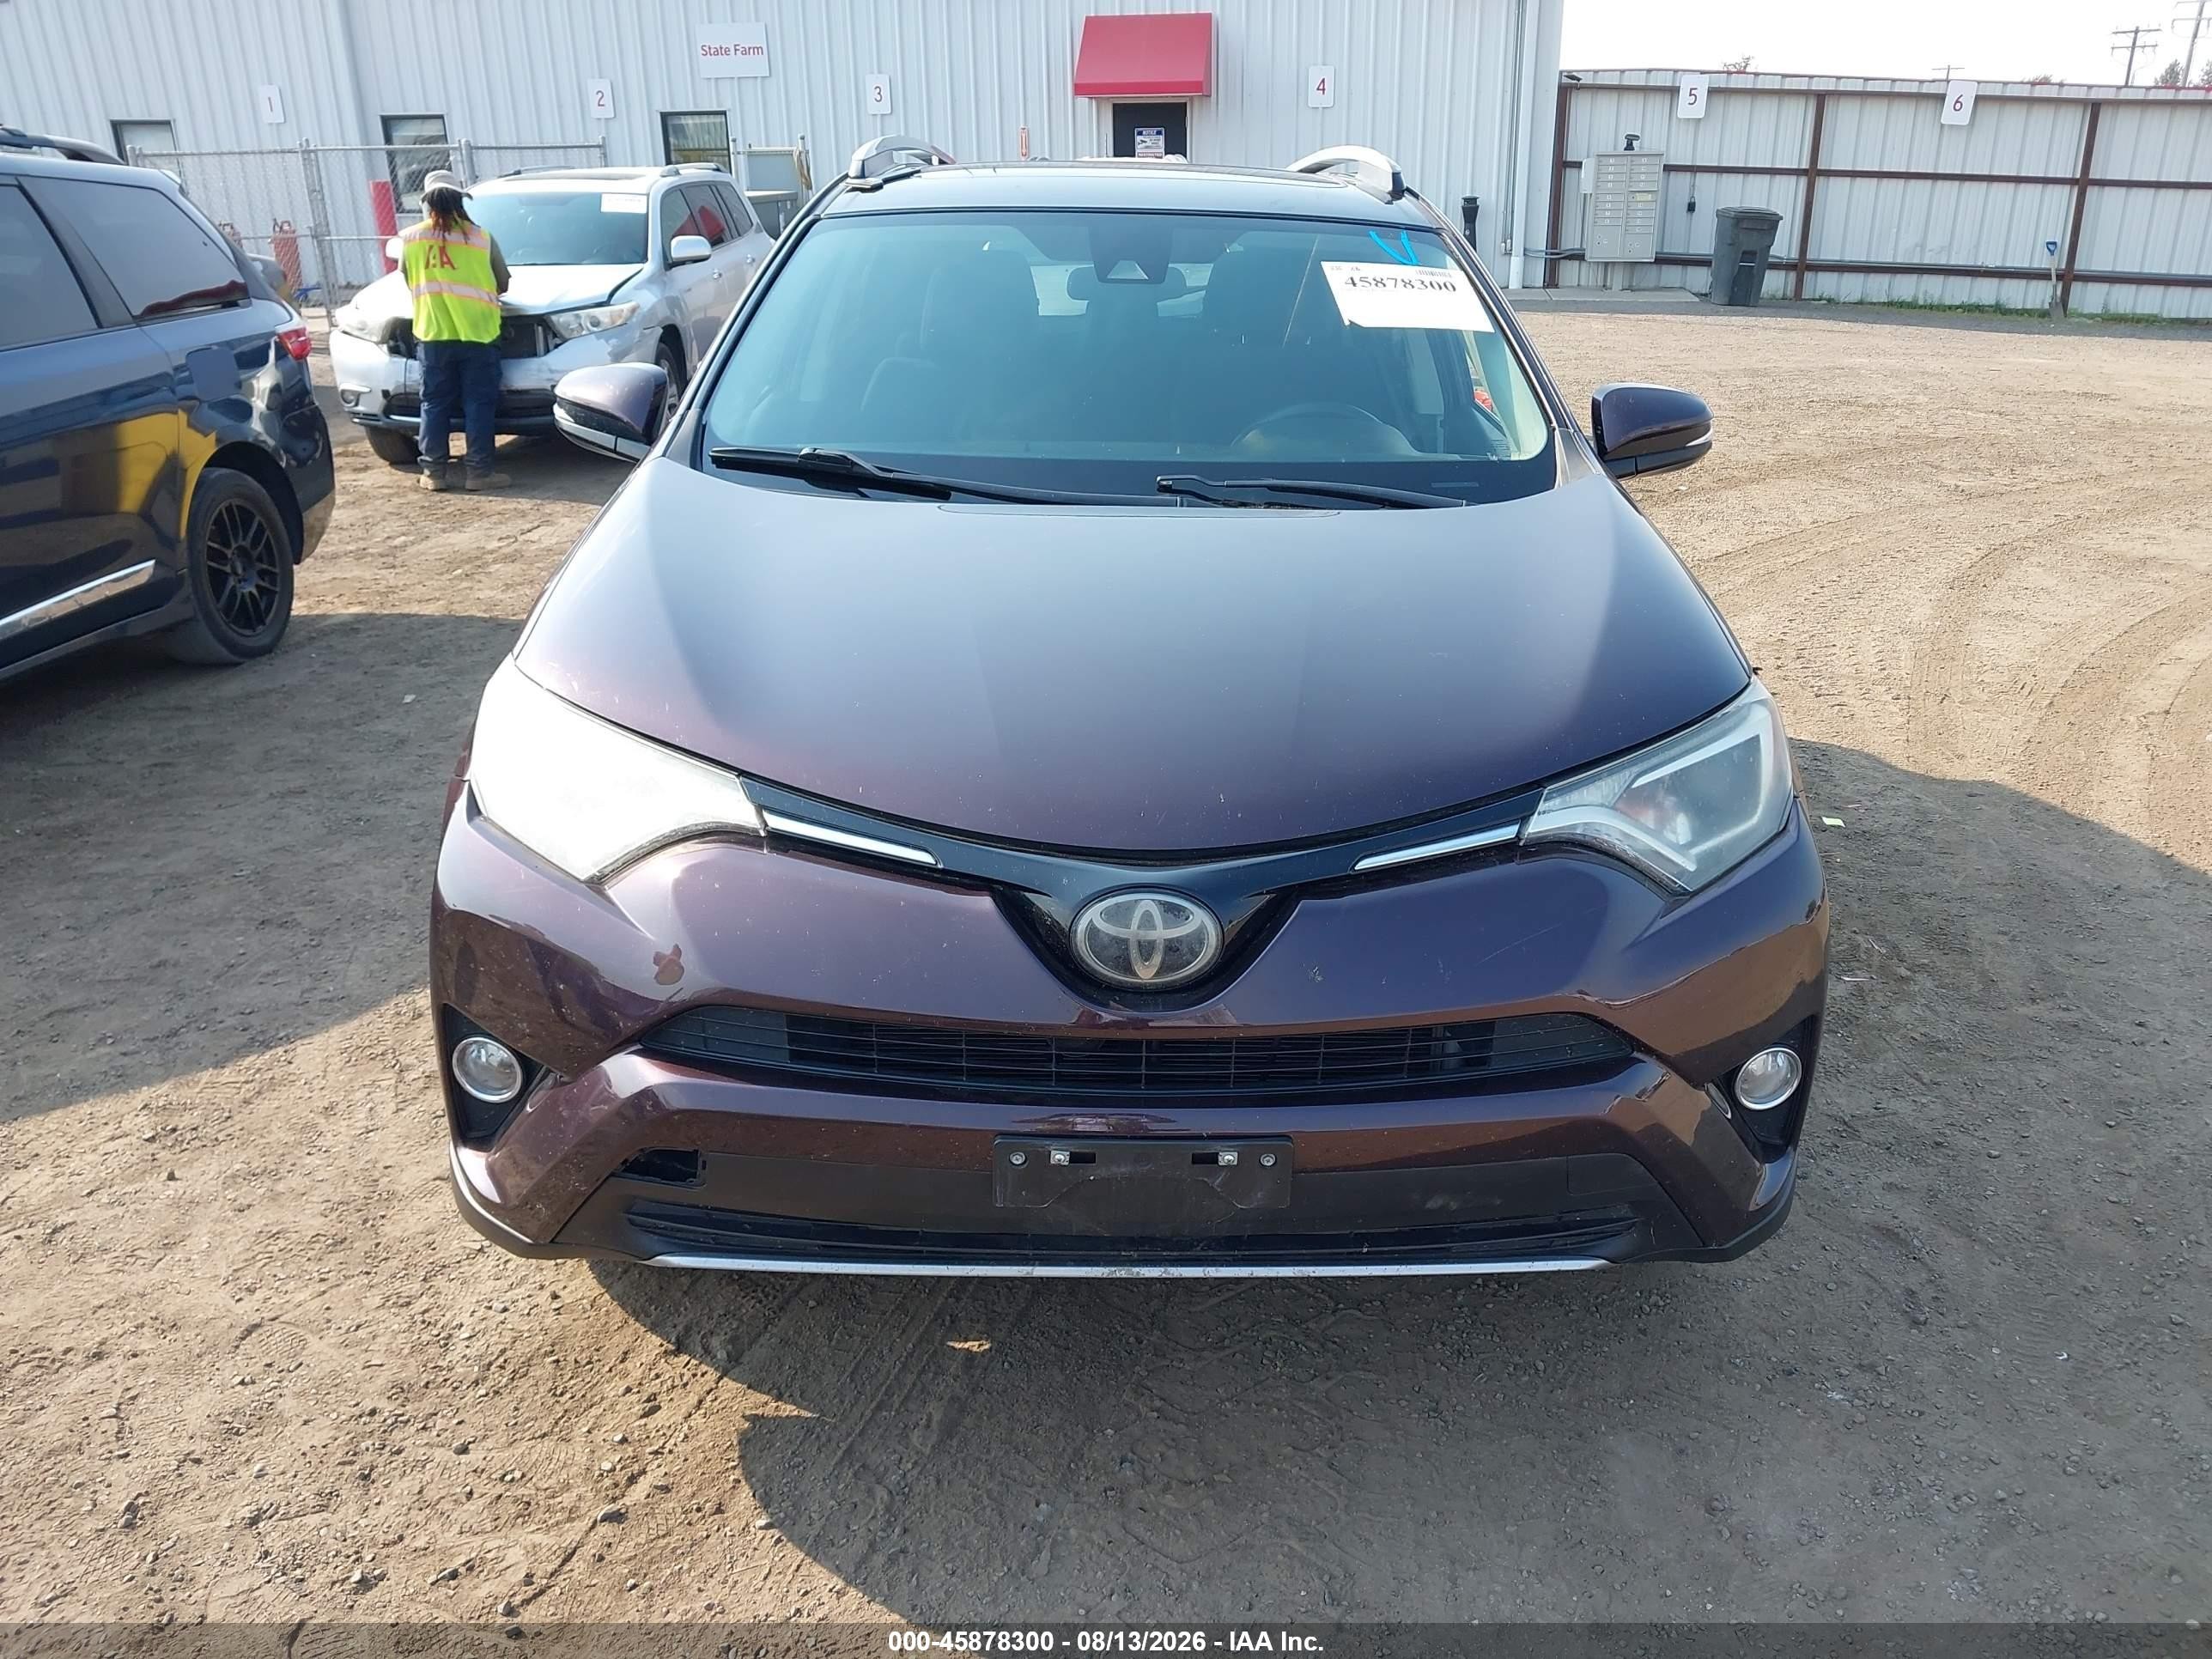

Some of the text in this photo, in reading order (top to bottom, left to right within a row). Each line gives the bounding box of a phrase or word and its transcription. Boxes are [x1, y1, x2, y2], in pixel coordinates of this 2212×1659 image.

[701, 44, 764, 57] State Farm
[873, 86, 883, 102] 3
[1316, 77, 1327, 95] 4
[268, 96, 273, 112] 1
[596, 90, 605, 106] 2
[1687, 88, 1698, 106] 5
[1953, 94, 1964, 112] 6
[1345, 276, 1457, 292] 45878300
